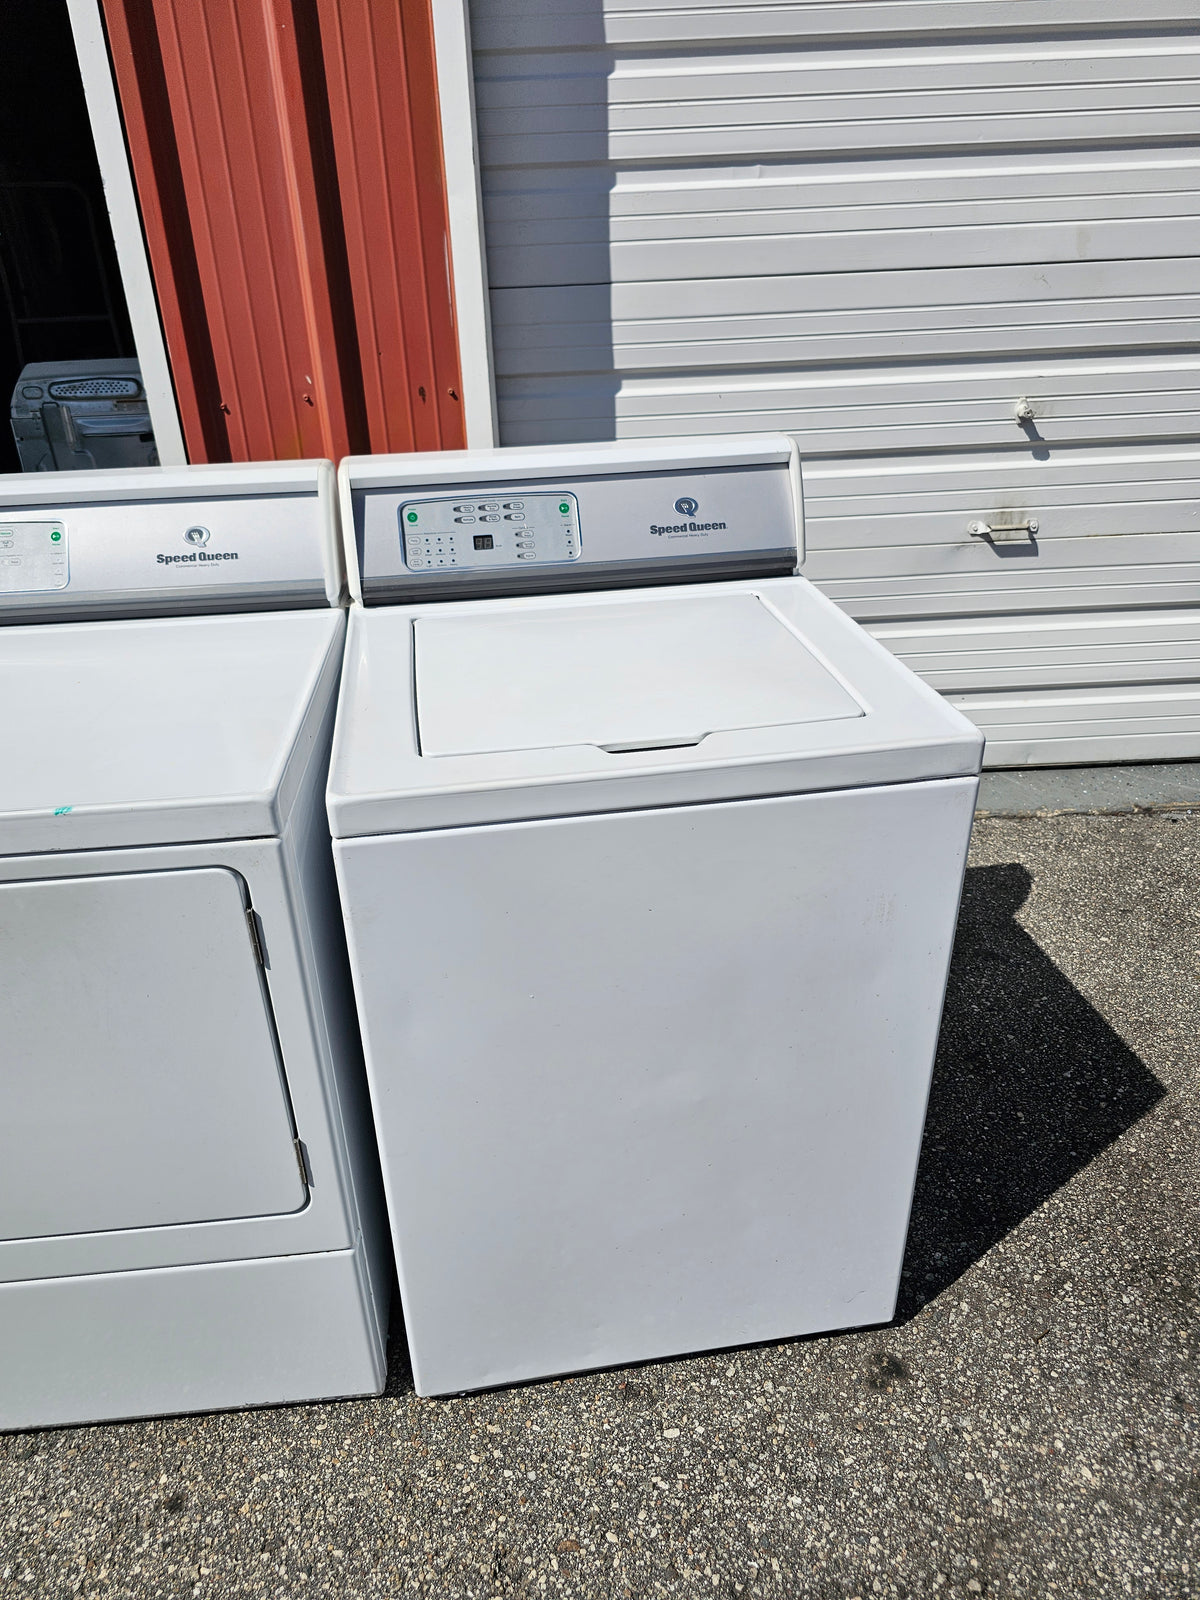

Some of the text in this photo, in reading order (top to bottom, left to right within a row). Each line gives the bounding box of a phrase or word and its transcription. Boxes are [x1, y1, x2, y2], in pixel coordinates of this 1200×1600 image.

[650, 522, 727, 536] Speed Queen
[156, 551, 239, 566] Speed Queen
